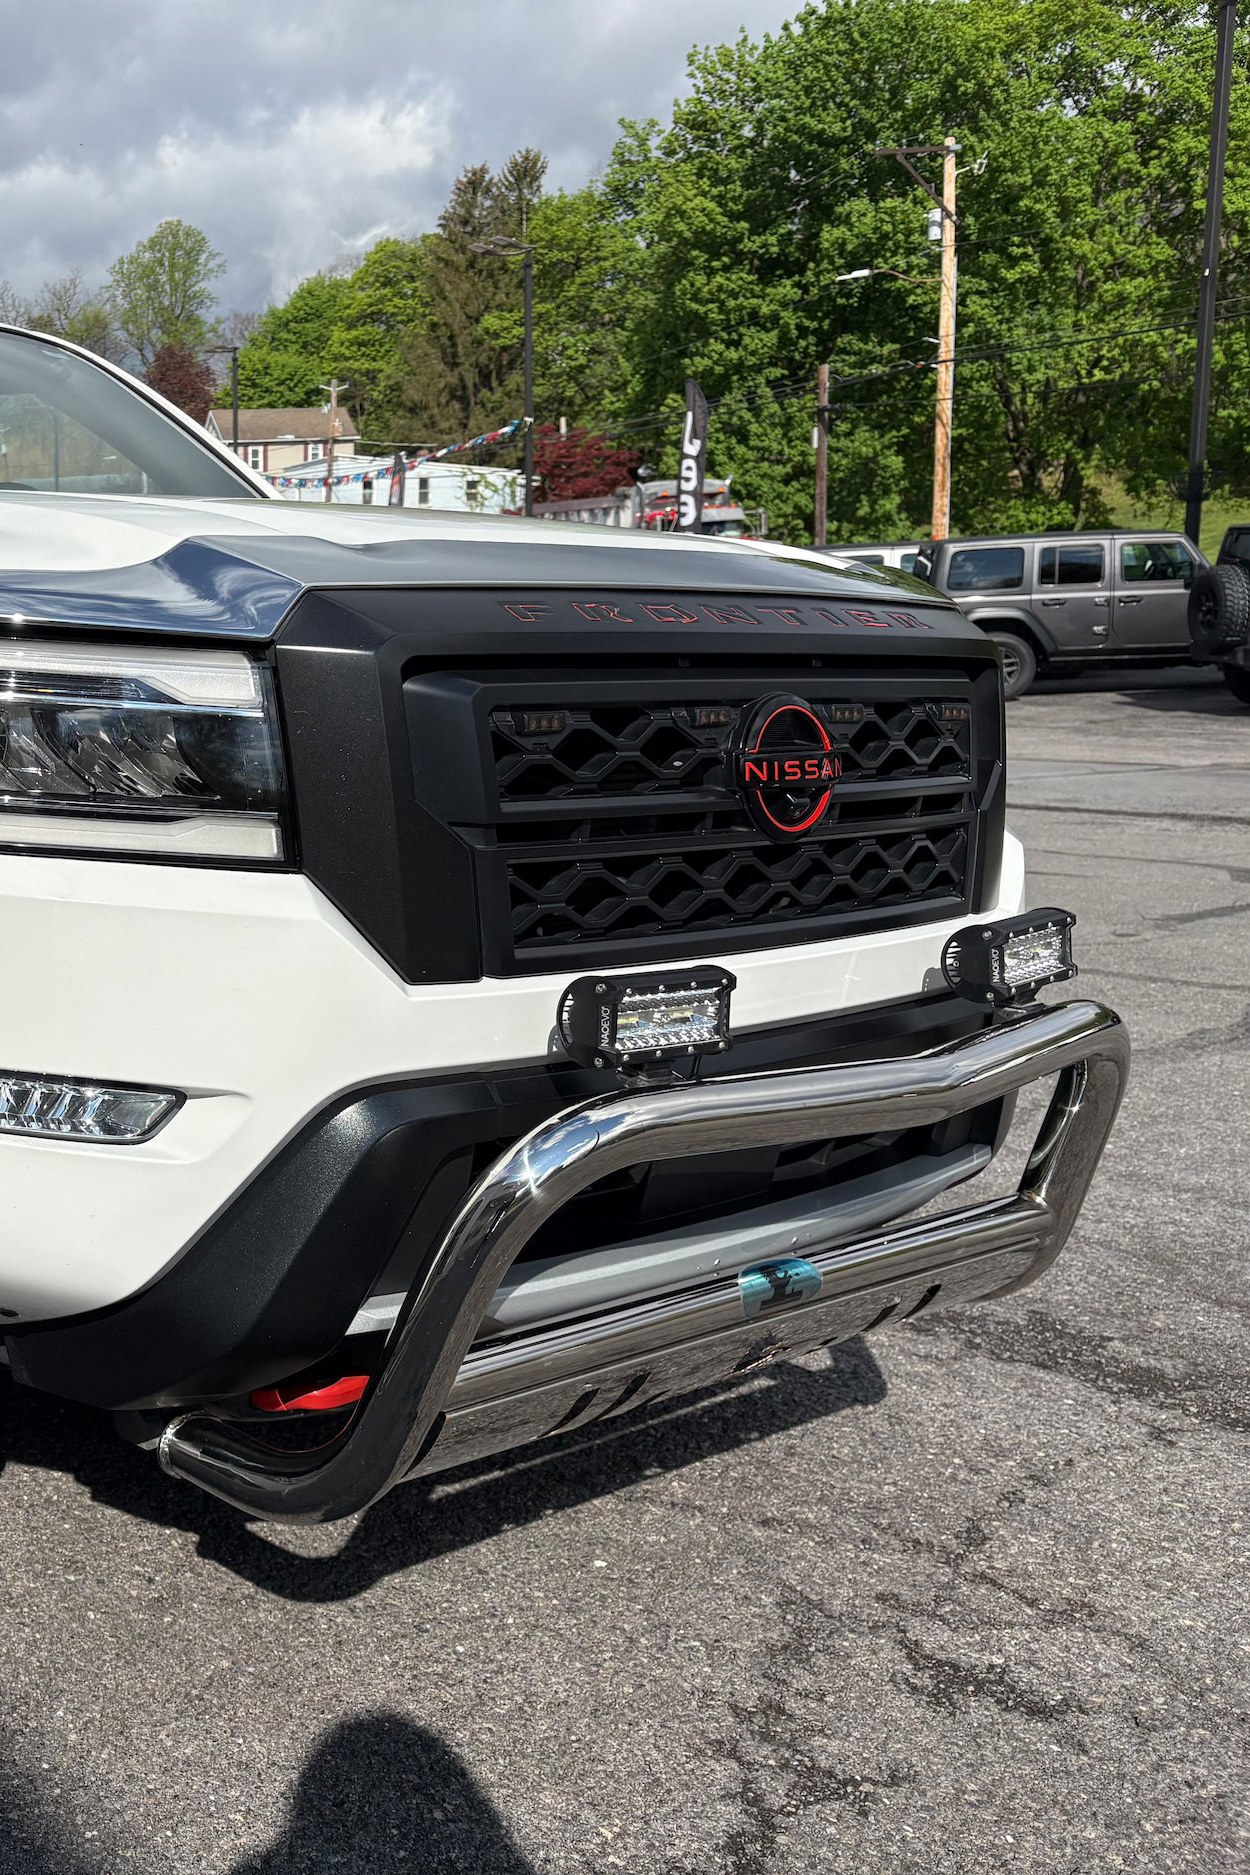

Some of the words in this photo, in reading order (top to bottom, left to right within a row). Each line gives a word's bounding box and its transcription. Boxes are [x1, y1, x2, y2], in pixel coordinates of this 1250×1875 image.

[500, 602, 934, 629] FRONTIER
[745, 758, 842, 781] NISSAN
[991, 949, 1000, 983] NAOEVO
[600, 1007, 610, 1047] NAOEVO
